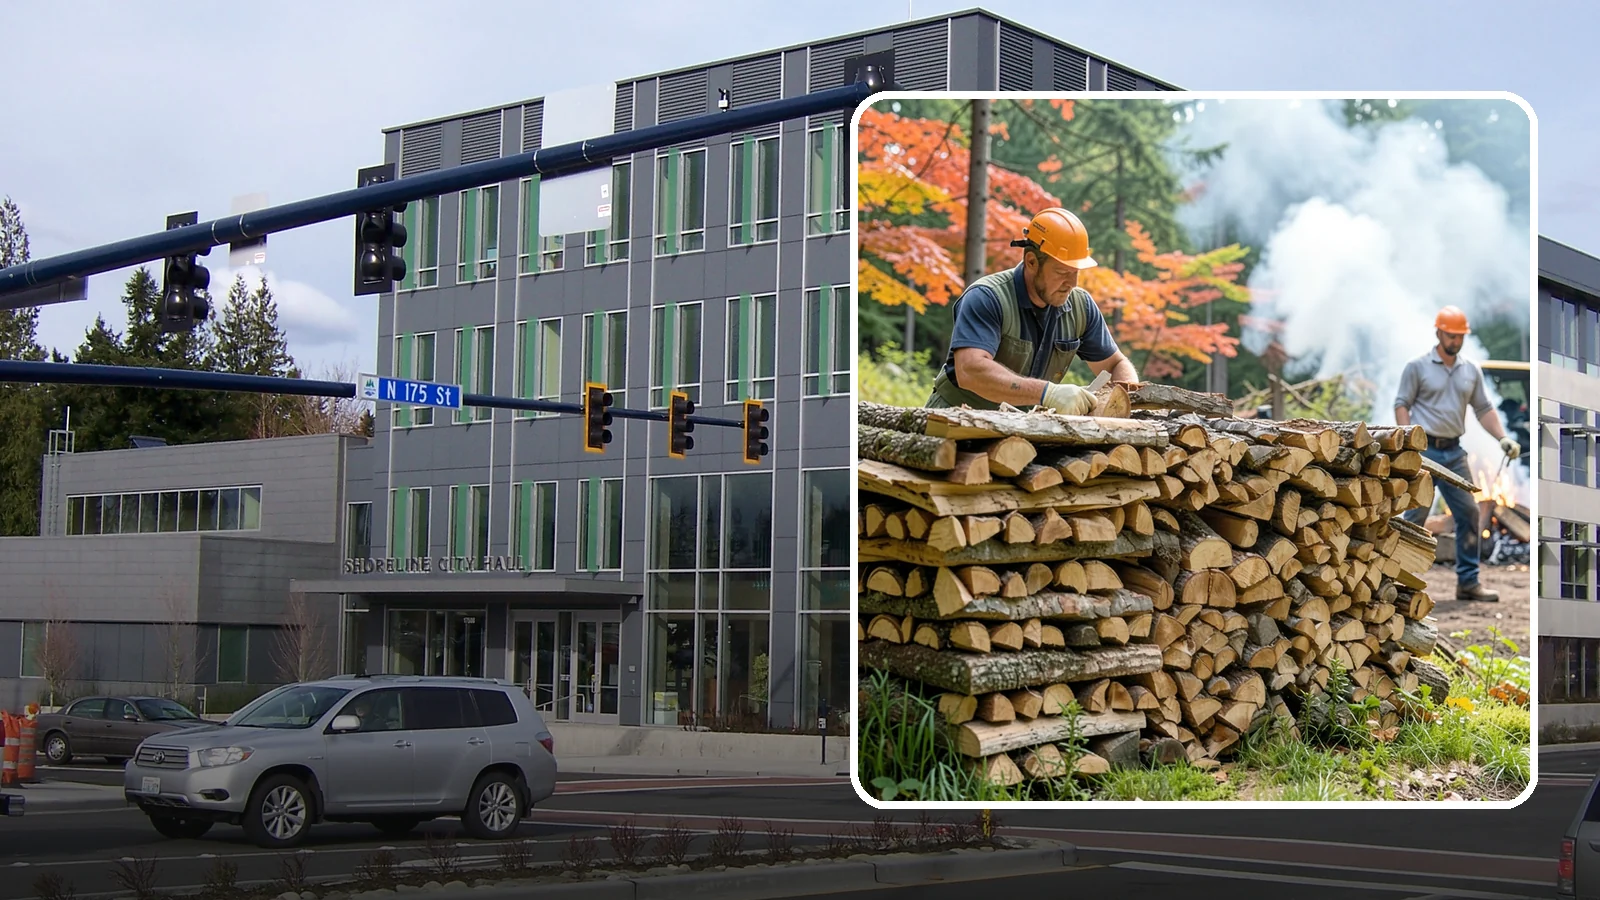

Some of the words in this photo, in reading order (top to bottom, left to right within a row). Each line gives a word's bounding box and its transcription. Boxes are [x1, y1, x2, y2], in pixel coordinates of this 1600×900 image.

[387, 381, 396, 400] N
[405, 382, 427, 403] 175
[436, 386, 451, 406] St
[343, 557, 431, 573] SHORELINE
[438, 556, 475, 572] CITY
[484, 556, 525, 572] HALL
